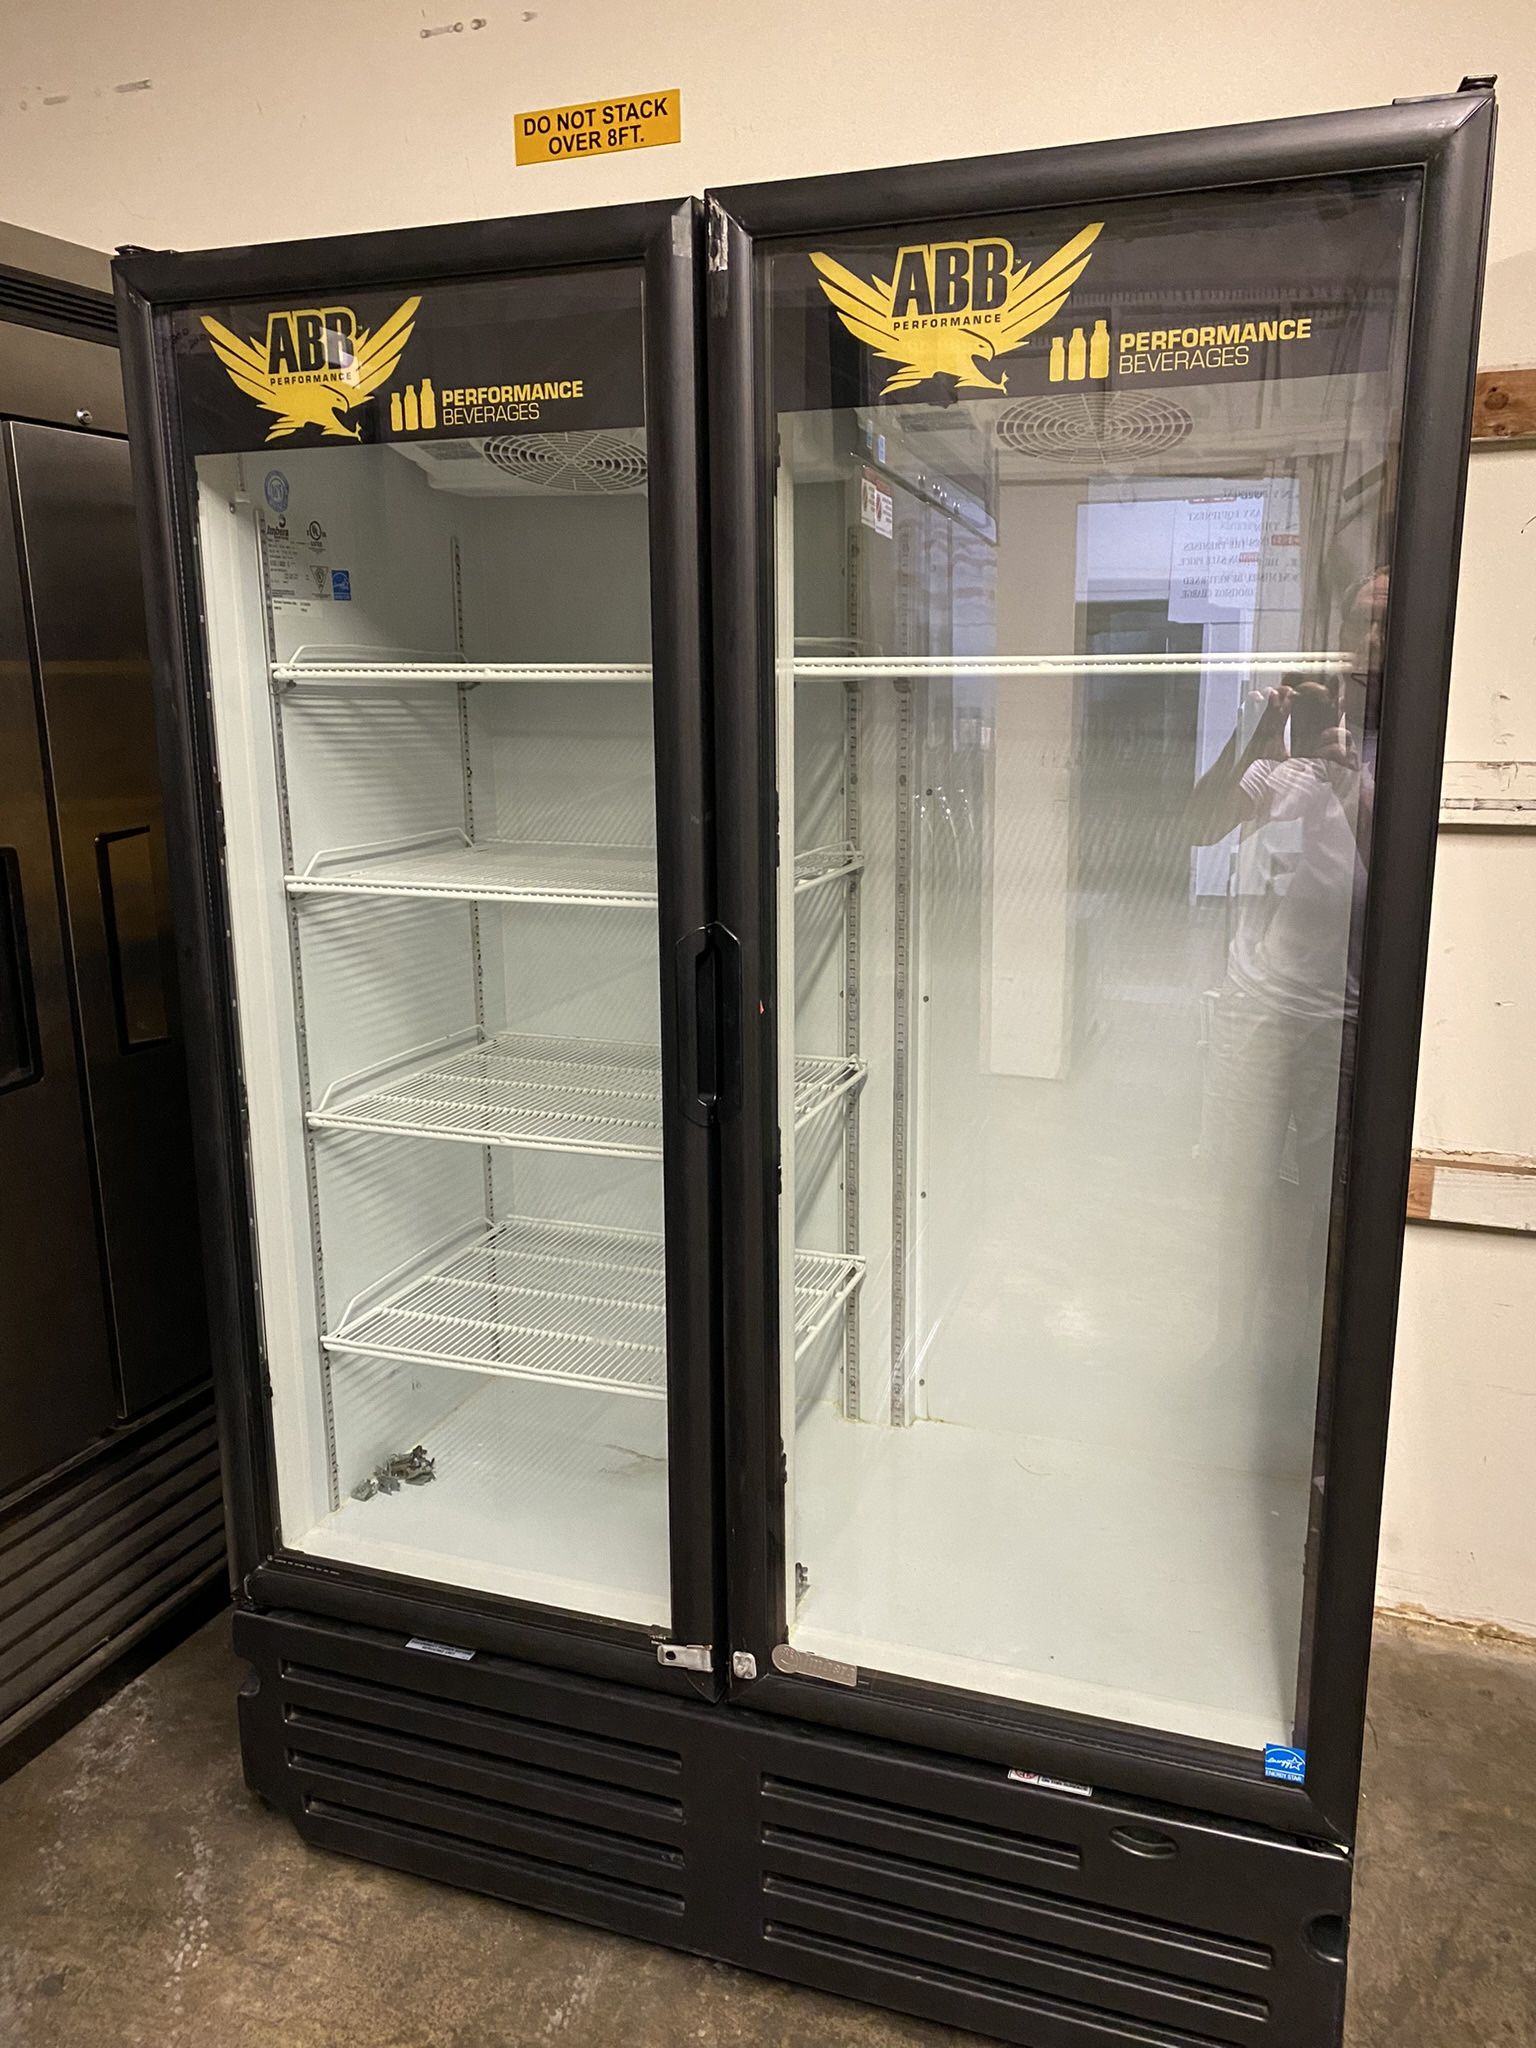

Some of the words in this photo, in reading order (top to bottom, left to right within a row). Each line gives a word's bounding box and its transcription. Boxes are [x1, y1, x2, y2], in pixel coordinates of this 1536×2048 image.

[523, 115, 550, 136] DO
[557, 109, 596, 132] NOT
[602, 97, 668, 124] STACK
[549, 130, 602, 155] OVER
[608, 124, 645, 147] 8FT.
[891, 238, 1012, 318] ABB
[893, 313, 1001, 331] PERFORMANCE
[1119, 318, 1312, 352] PERFORMANCE
[266, 307, 356, 374] ABB
[1119, 345, 1249, 375] BEVERAGES
[270, 372, 352, 386] PERFORMANCE
[441, 380, 584, 407] PERFORMANCE
[442, 402, 540, 426] BEVERAGES
